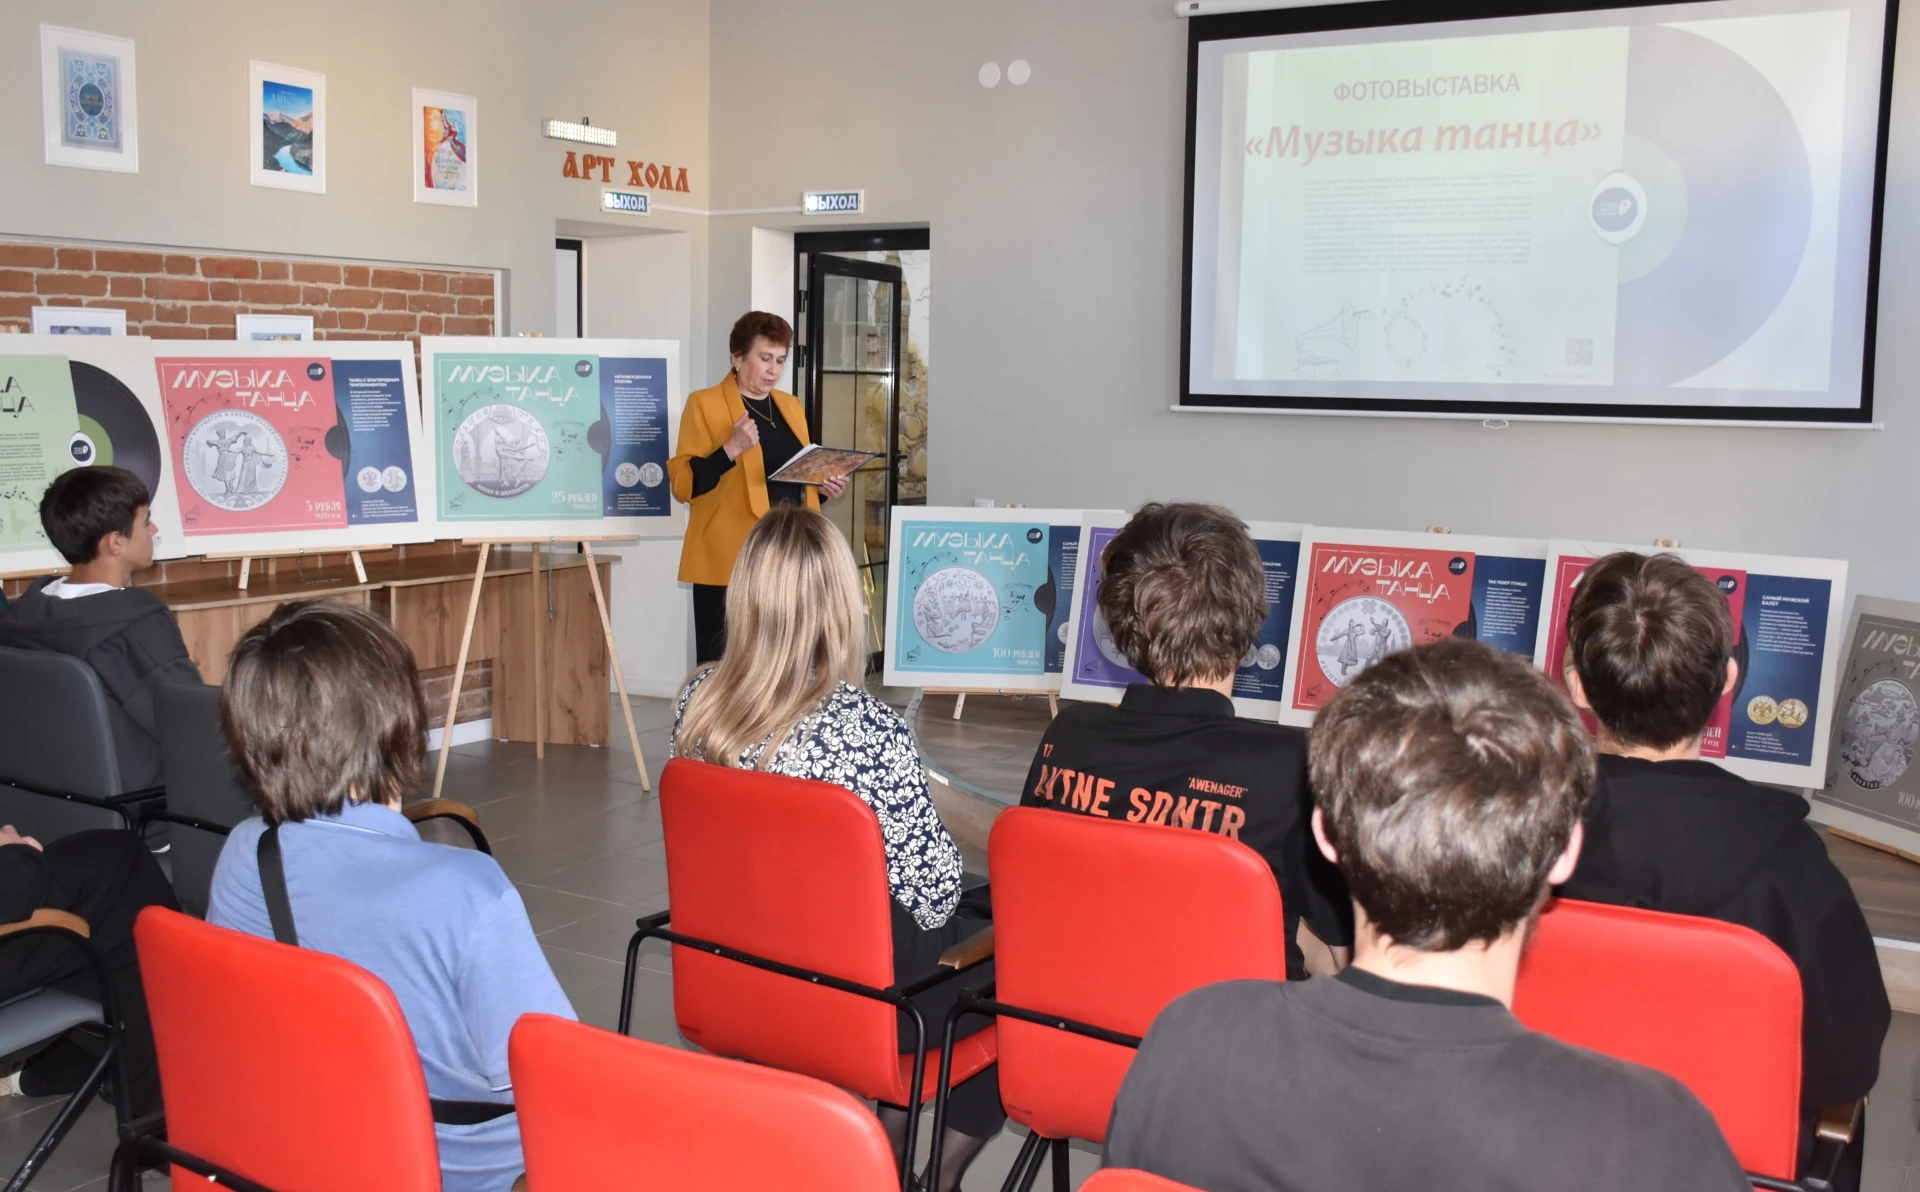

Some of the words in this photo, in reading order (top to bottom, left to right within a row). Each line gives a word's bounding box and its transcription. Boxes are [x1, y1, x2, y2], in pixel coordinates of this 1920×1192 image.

[1333, 73, 1521, 102] ФОТОВЫСТАВКА
[1245, 124, 1424, 167] «Музыка
[1435, 118, 1602, 157] танца»
[562, 151, 615, 183] АРТ
[627, 160, 690, 192] ХОЛЛ
[604, 192, 646, 211] ВЫХОД
[806, 193, 858, 211] ВЫХОД
[172, 369, 295, 389] МУЗЫКА
[448, 365, 562, 384] МУЗЫКА
[236, 391, 316, 412] ТАНЦА
[505, 386, 582, 406] ТАНЦА
[306, 500, 312, 512] 3
[315, 501, 342, 512] РУБЛЯ
[552, 491, 566, 503] 25
[913, 532, 1014, 549] МУЗЫКА
[963, 551, 1031, 570] ТАНЦА
[1322, 556, 1433, 579] МУЗЫКА
[1376, 580, 1450, 604] ТАНЦА
[992, 647, 1011, 658] 100
[1898, 791, 1915, 808] 100
